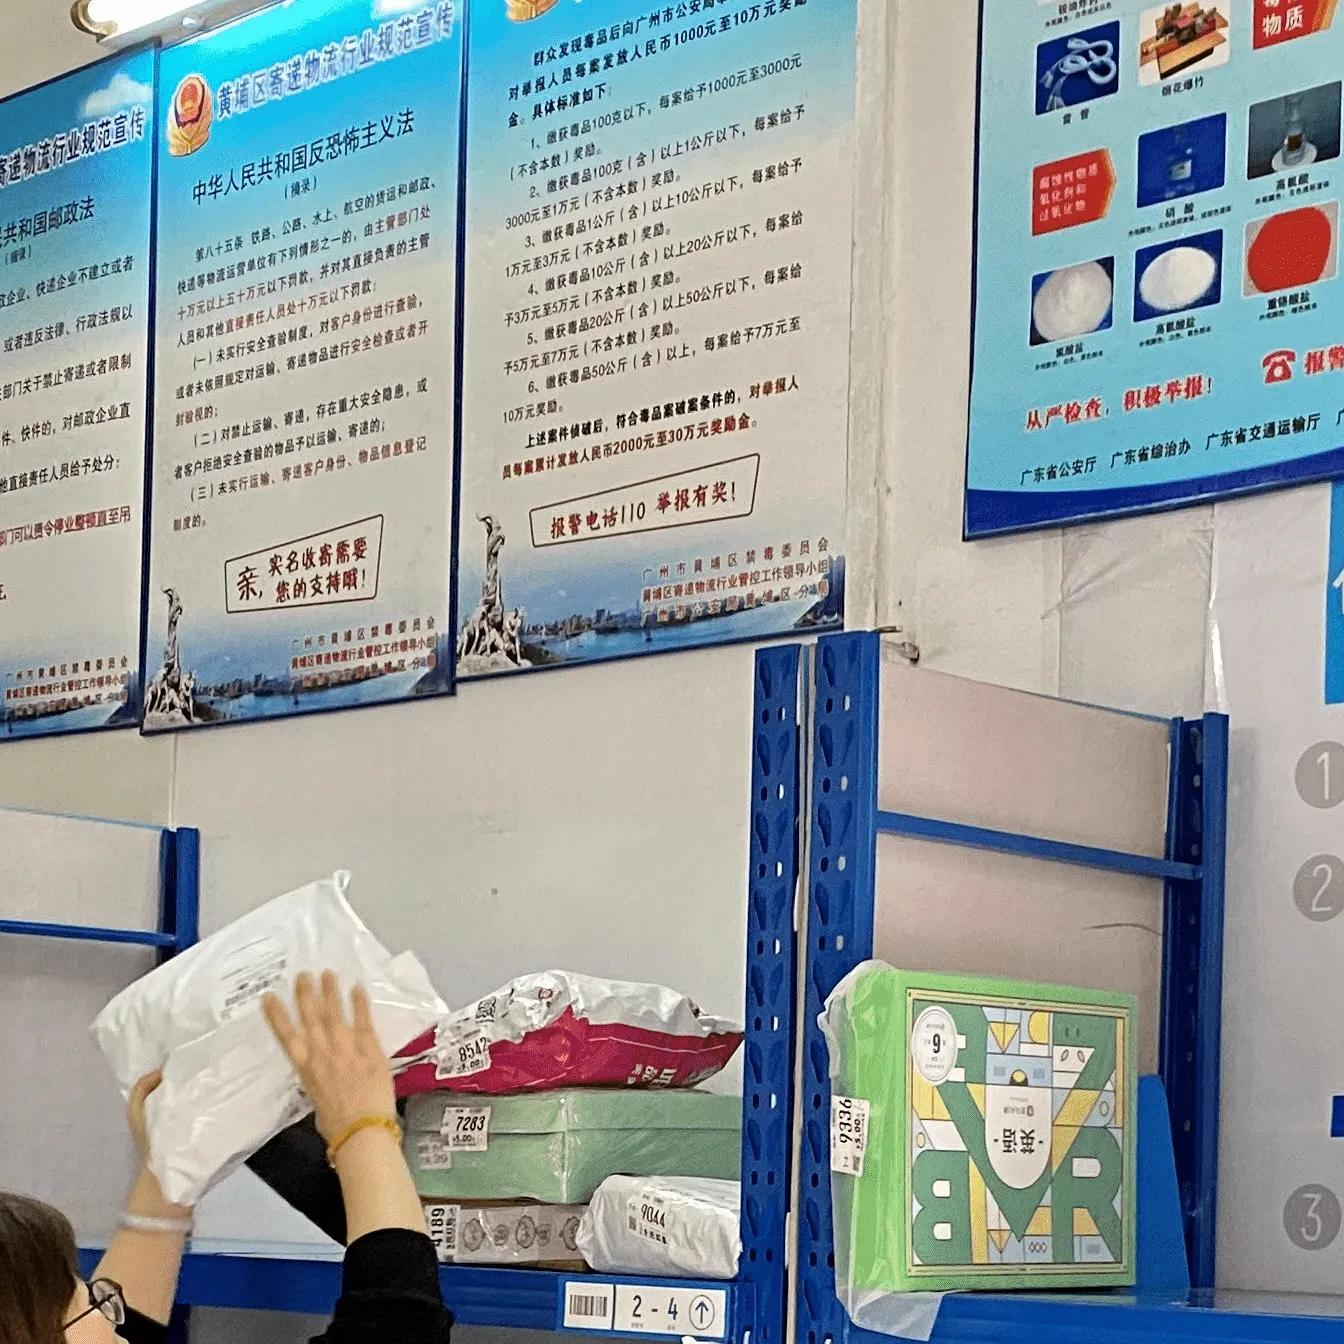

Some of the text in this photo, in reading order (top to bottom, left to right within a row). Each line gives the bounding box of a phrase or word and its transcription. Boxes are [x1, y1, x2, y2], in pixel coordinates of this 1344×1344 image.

[1262, 6, 1303, 38] 物质
[216, 1, 454, 120] 黄埔区寄递物流行业规范宣传
[192, 107, 414, 205] 中华人民共和国反恐怖主义法
[1020, 456, 1098, 485] 广东省公安厅
[1205, 412, 1321, 451] 广东省交通运输厅
[268, 536, 368, 576] 实名收寄需要
[459, 1037, 487, 1062] 8542
[456, 1116, 485, 1131] 7283
[840, 1099, 852, 1145] 9336
[640, 1204, 666, 1228] 9044
